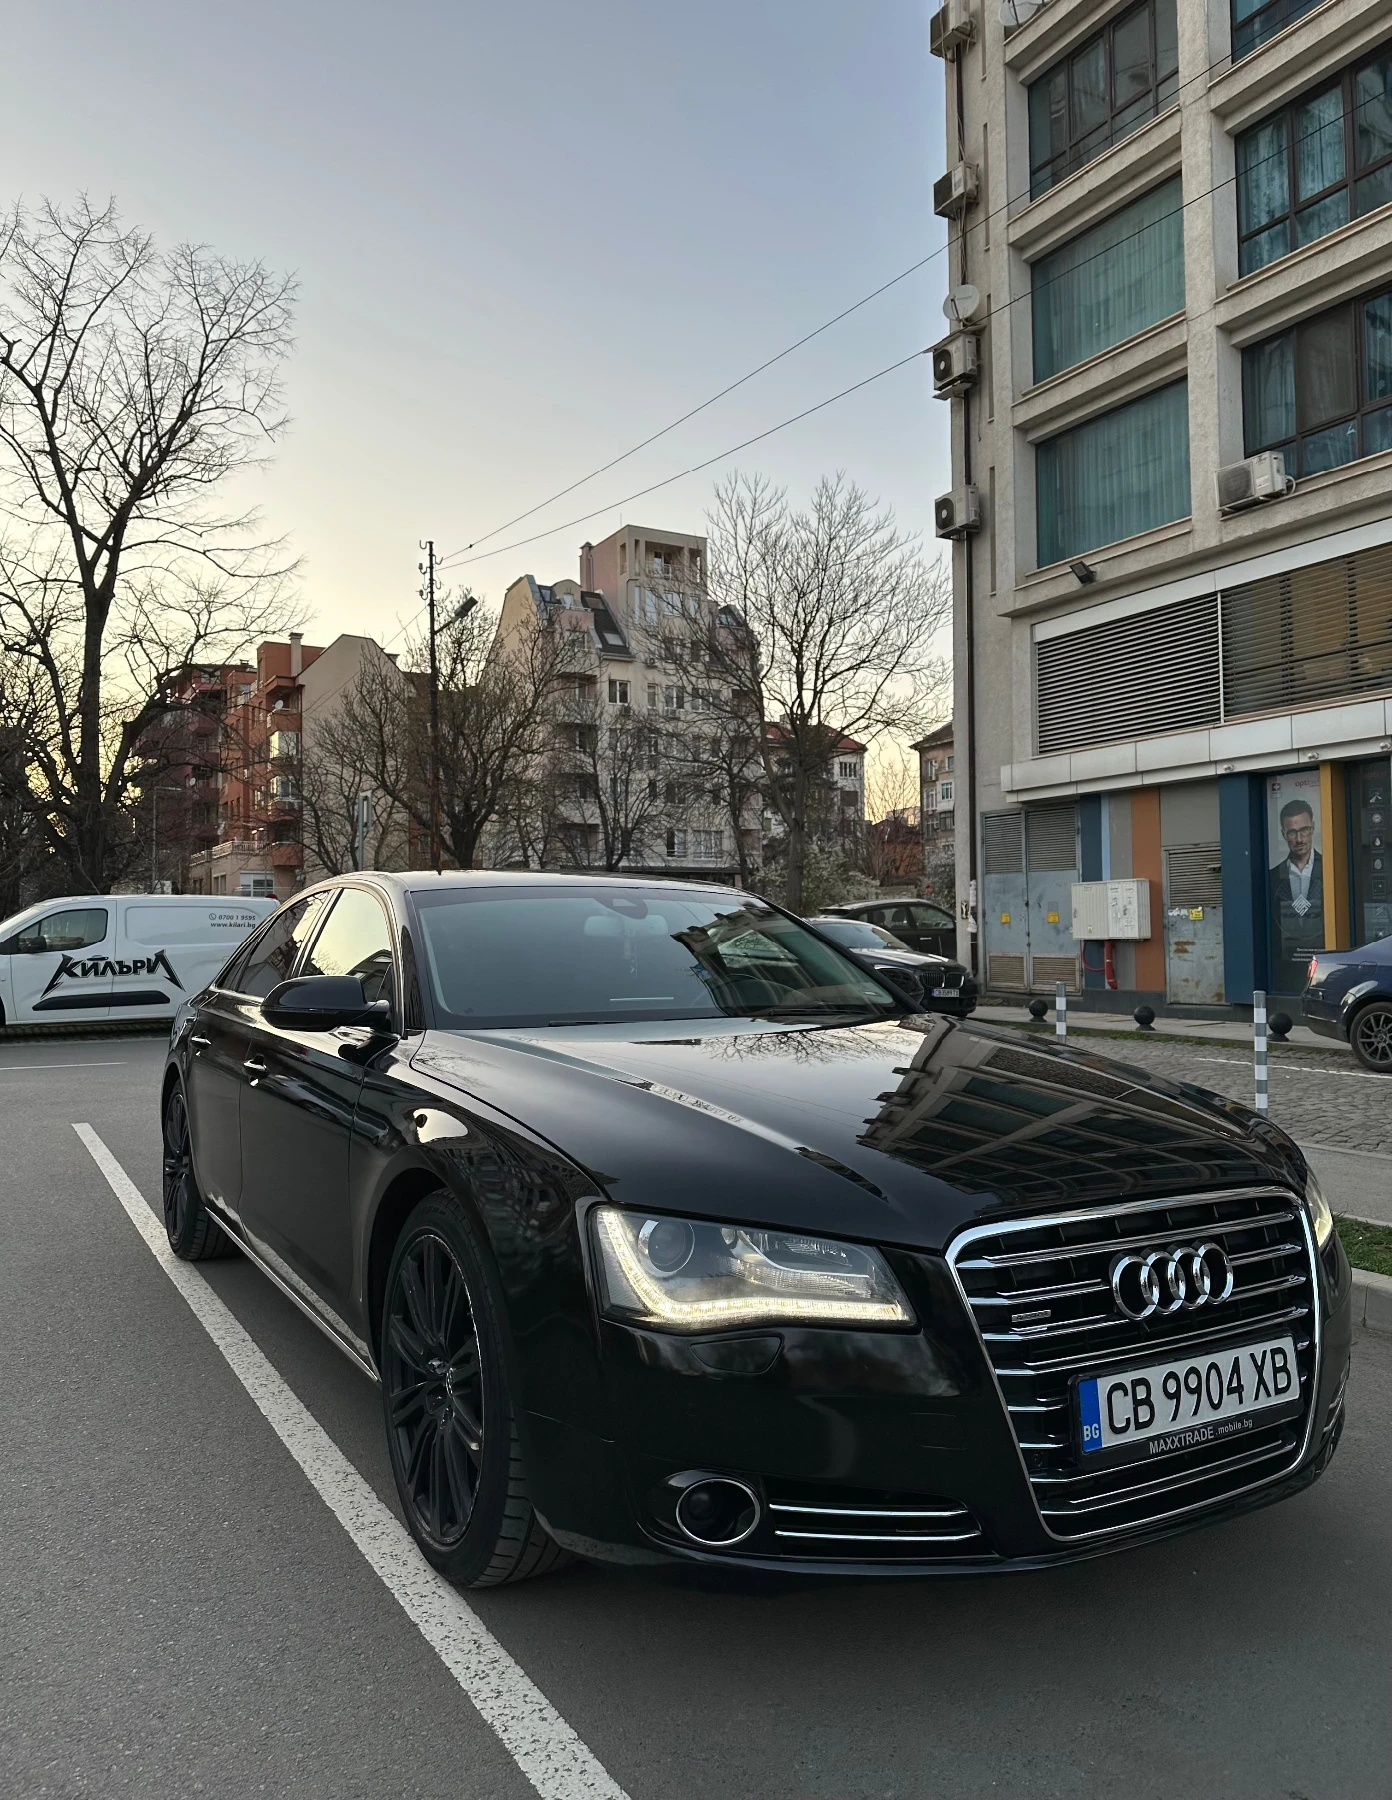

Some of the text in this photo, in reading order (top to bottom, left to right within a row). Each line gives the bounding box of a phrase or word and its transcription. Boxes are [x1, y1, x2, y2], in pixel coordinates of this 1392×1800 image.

[210, 921, 256, 929] www.kilari.bg
[40, 949, 186, 1000] КИЛЪРИ
[1106, 1346, 1292, 1435] CB 9904 XB
[1083, 1424, 1100, 1442] BG
